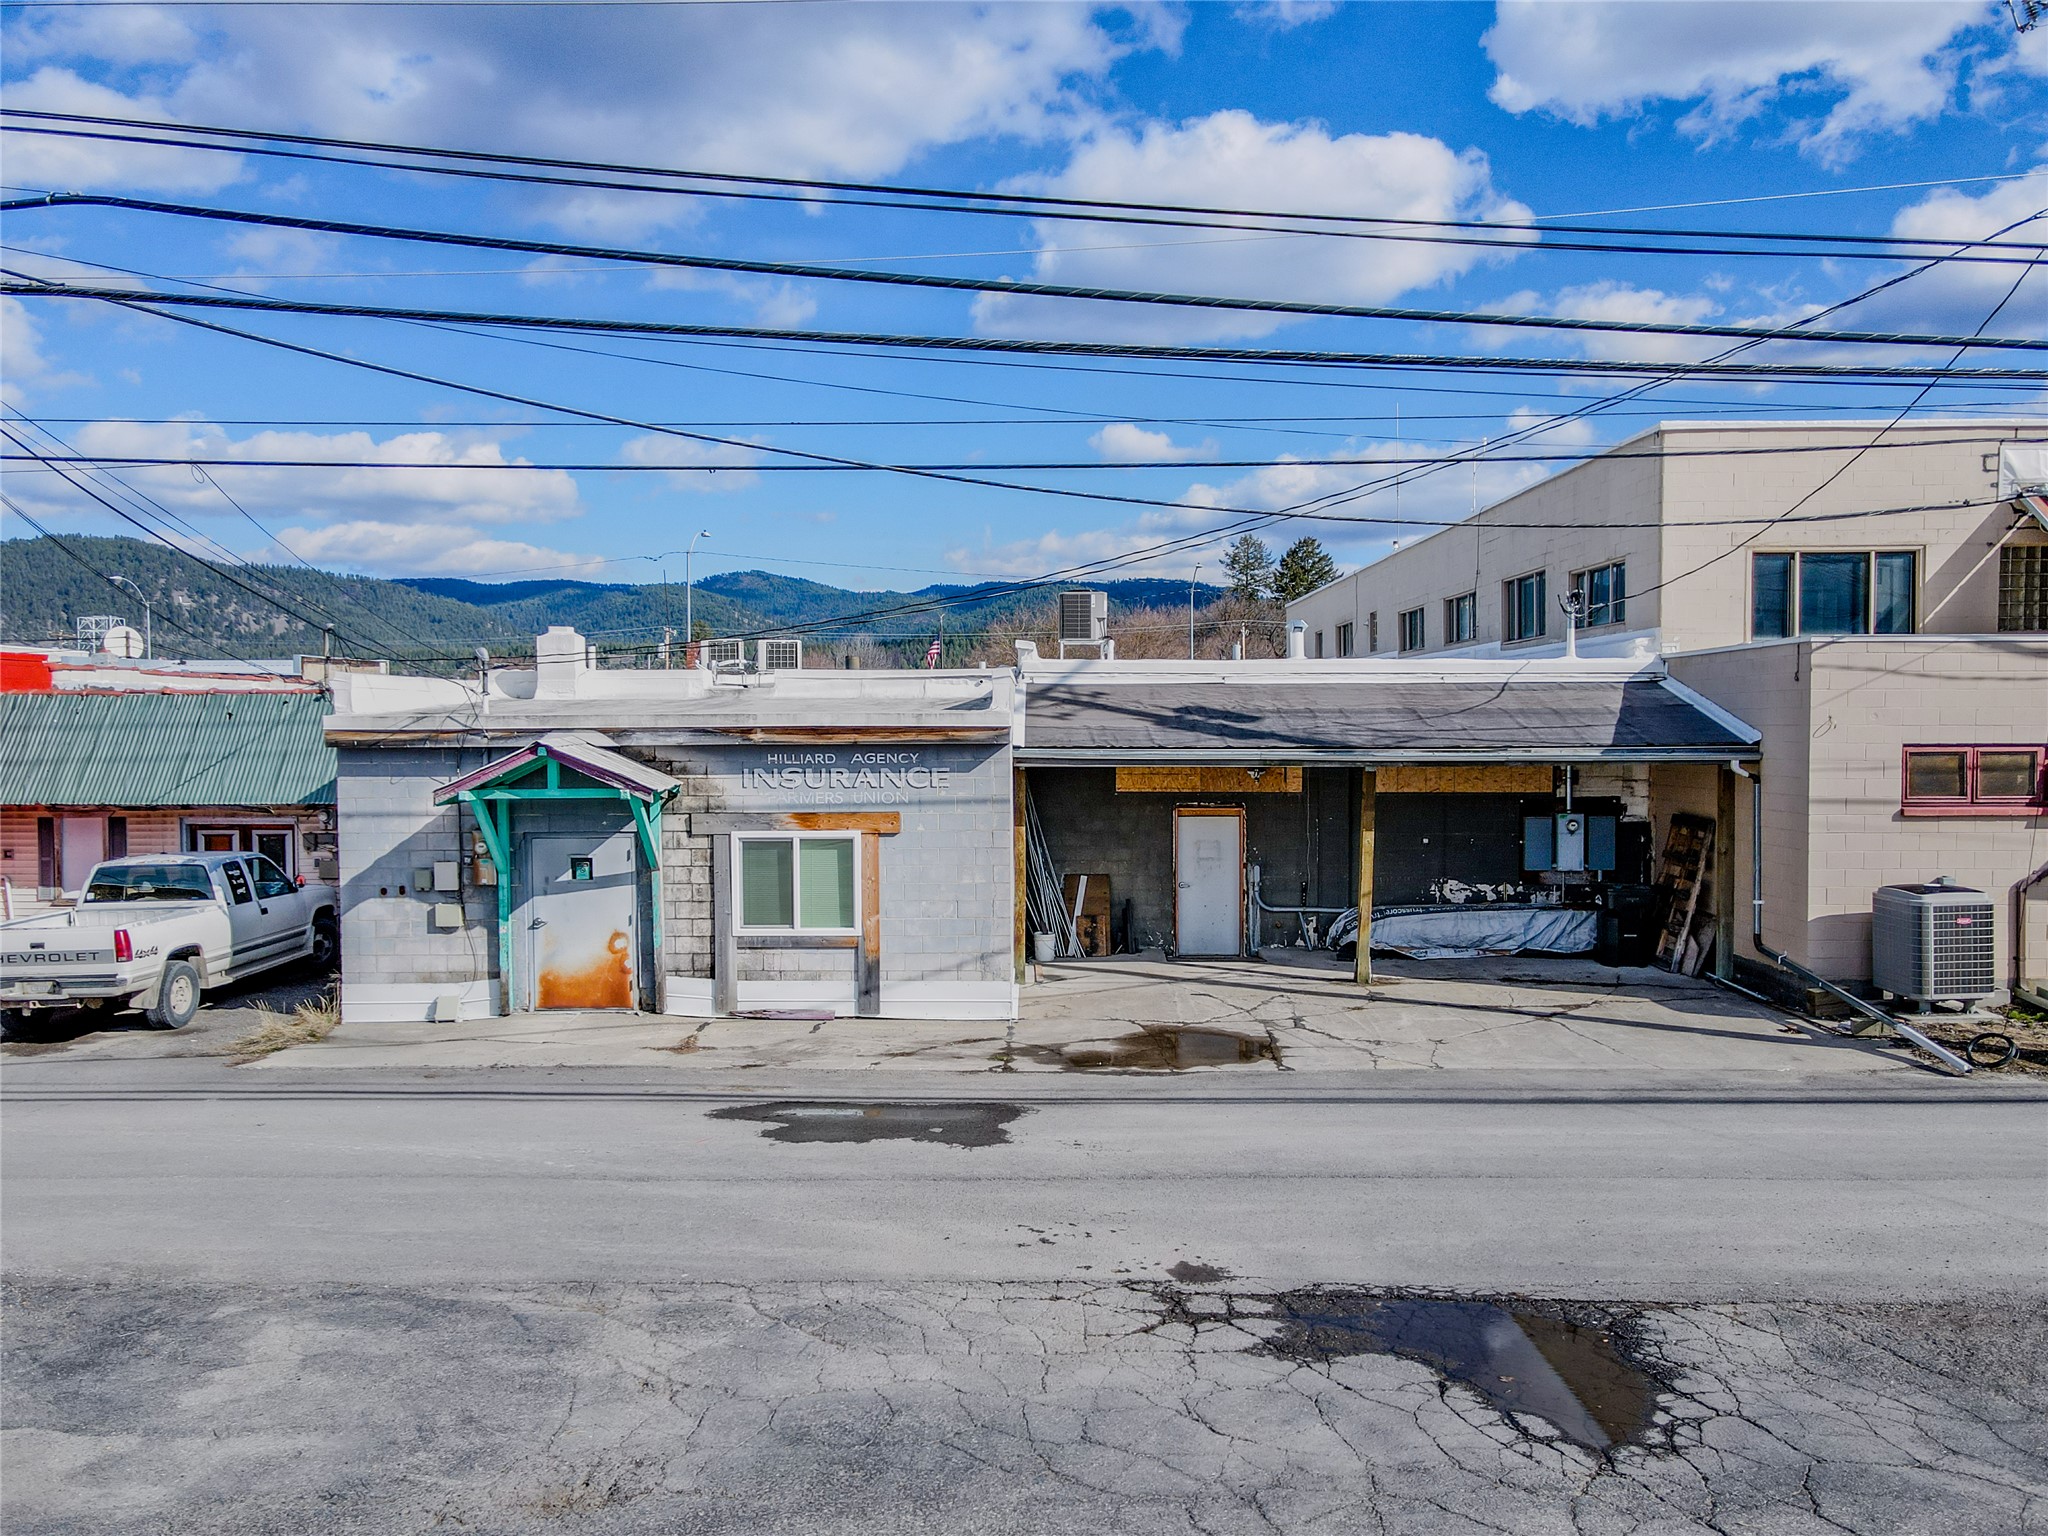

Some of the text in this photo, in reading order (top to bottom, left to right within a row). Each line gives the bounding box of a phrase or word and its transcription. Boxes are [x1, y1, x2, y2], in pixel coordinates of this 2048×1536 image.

[767, 752, 919, 765] HILLIARD AGENCY
[741, 767, 950, 789] INSURANCE
[853, 791, 909, 804] UNION
